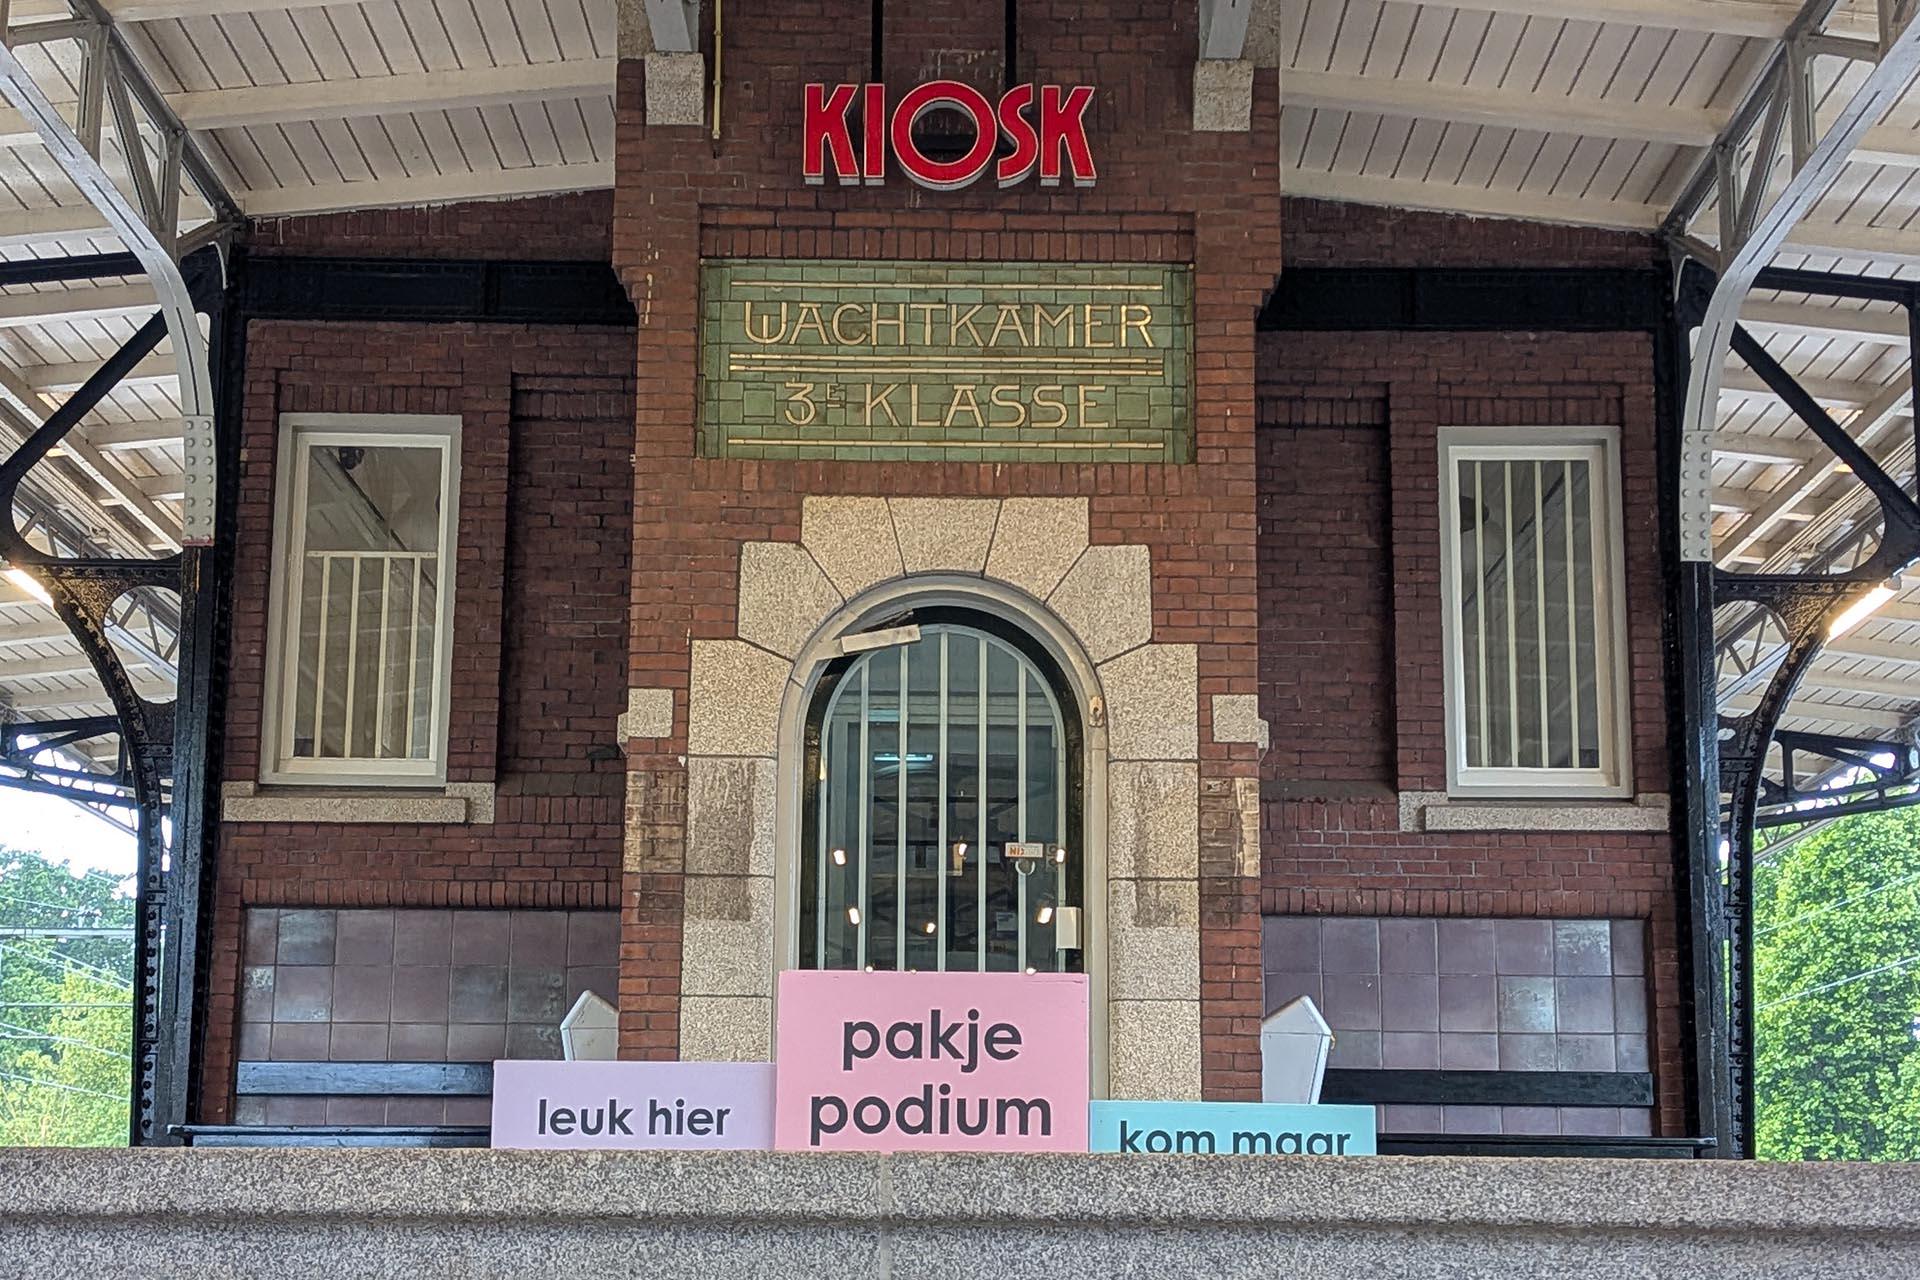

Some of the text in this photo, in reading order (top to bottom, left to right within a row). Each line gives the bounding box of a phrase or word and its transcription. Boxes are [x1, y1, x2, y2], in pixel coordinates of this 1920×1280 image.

[802, 80, 1097, 189] KIOSK
[743, 301, 1155, 348] WACHTKAMER
[864, 383, 1109, 428] KLASSE
[842, 1008, 1022, 1073] pakje
[537, 1098, 731, 1135] leuk hier
[810, 1083, 1051, 1146] podium
[1119, 1120, 1351, 1155] kom maar
